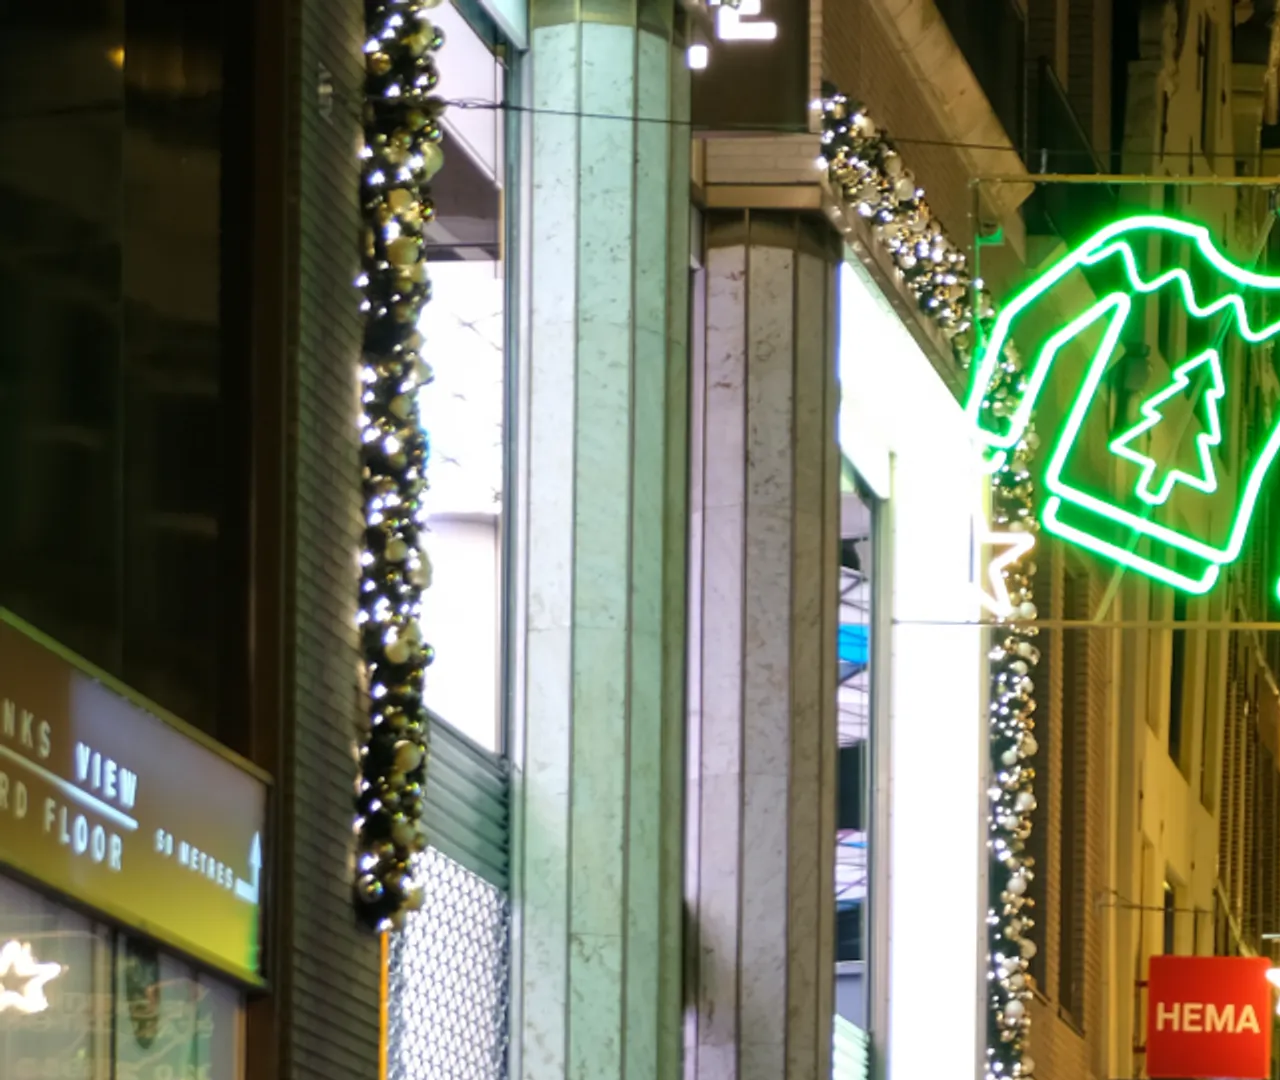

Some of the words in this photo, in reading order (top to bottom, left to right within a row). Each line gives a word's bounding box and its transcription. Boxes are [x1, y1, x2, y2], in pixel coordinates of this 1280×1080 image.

[75, 741, 138, 809] VIEW
[44, 797, 123, 872] FLOOR
[155, 828, 174, 856] 50
[178, 840, 234, 889] METRES
[1156, 1002, 1261, 1035] HEMA
